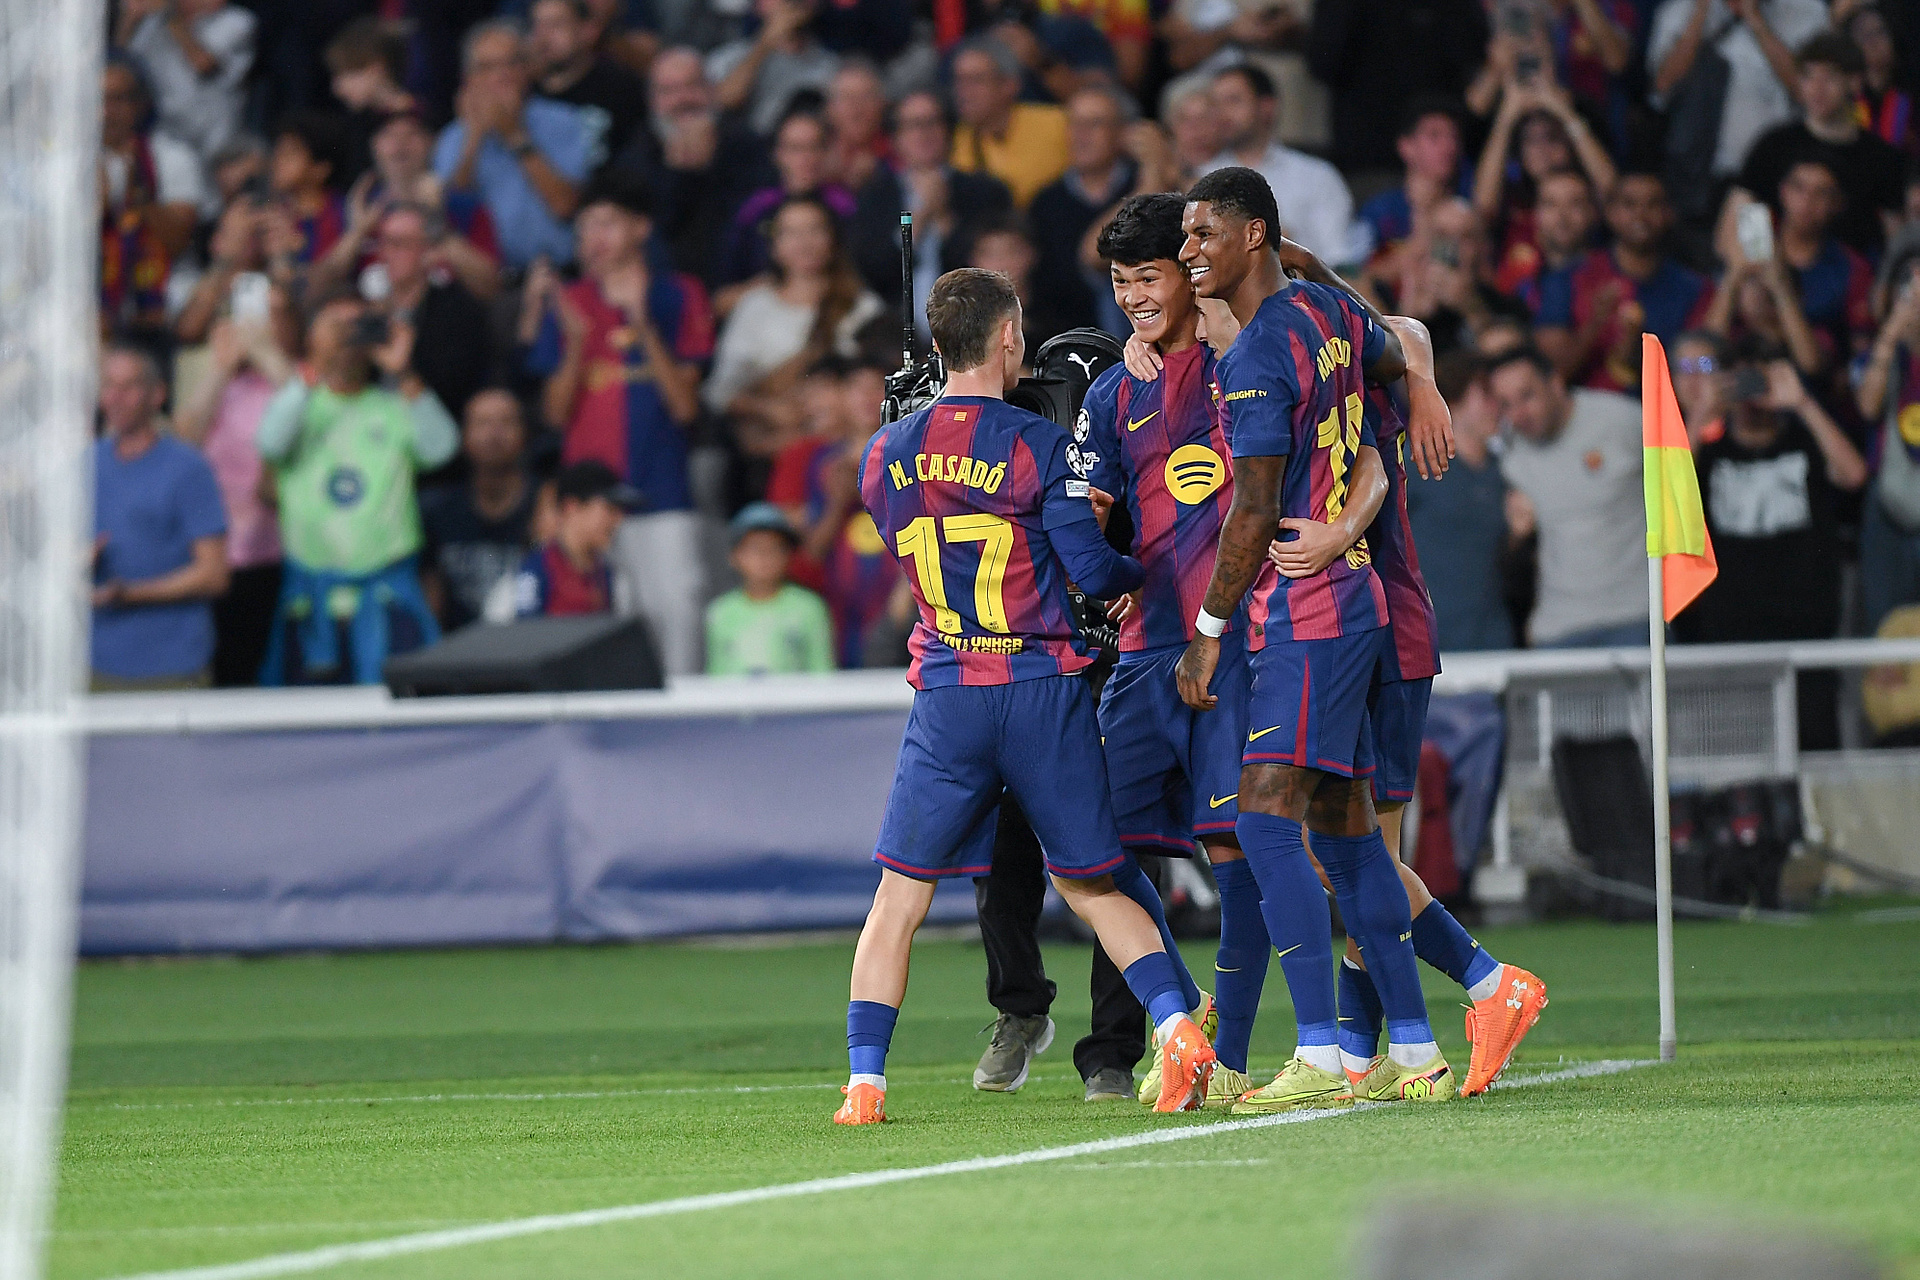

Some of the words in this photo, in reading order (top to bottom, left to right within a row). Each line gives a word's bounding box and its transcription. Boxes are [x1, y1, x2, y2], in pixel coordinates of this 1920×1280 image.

[888, 460, 914, 491] M.
[915, 453, 1008, 495] CASADÓ
[895, 512, 1015, 635] 17
[970, 636, 1023, 648] UNHCR
